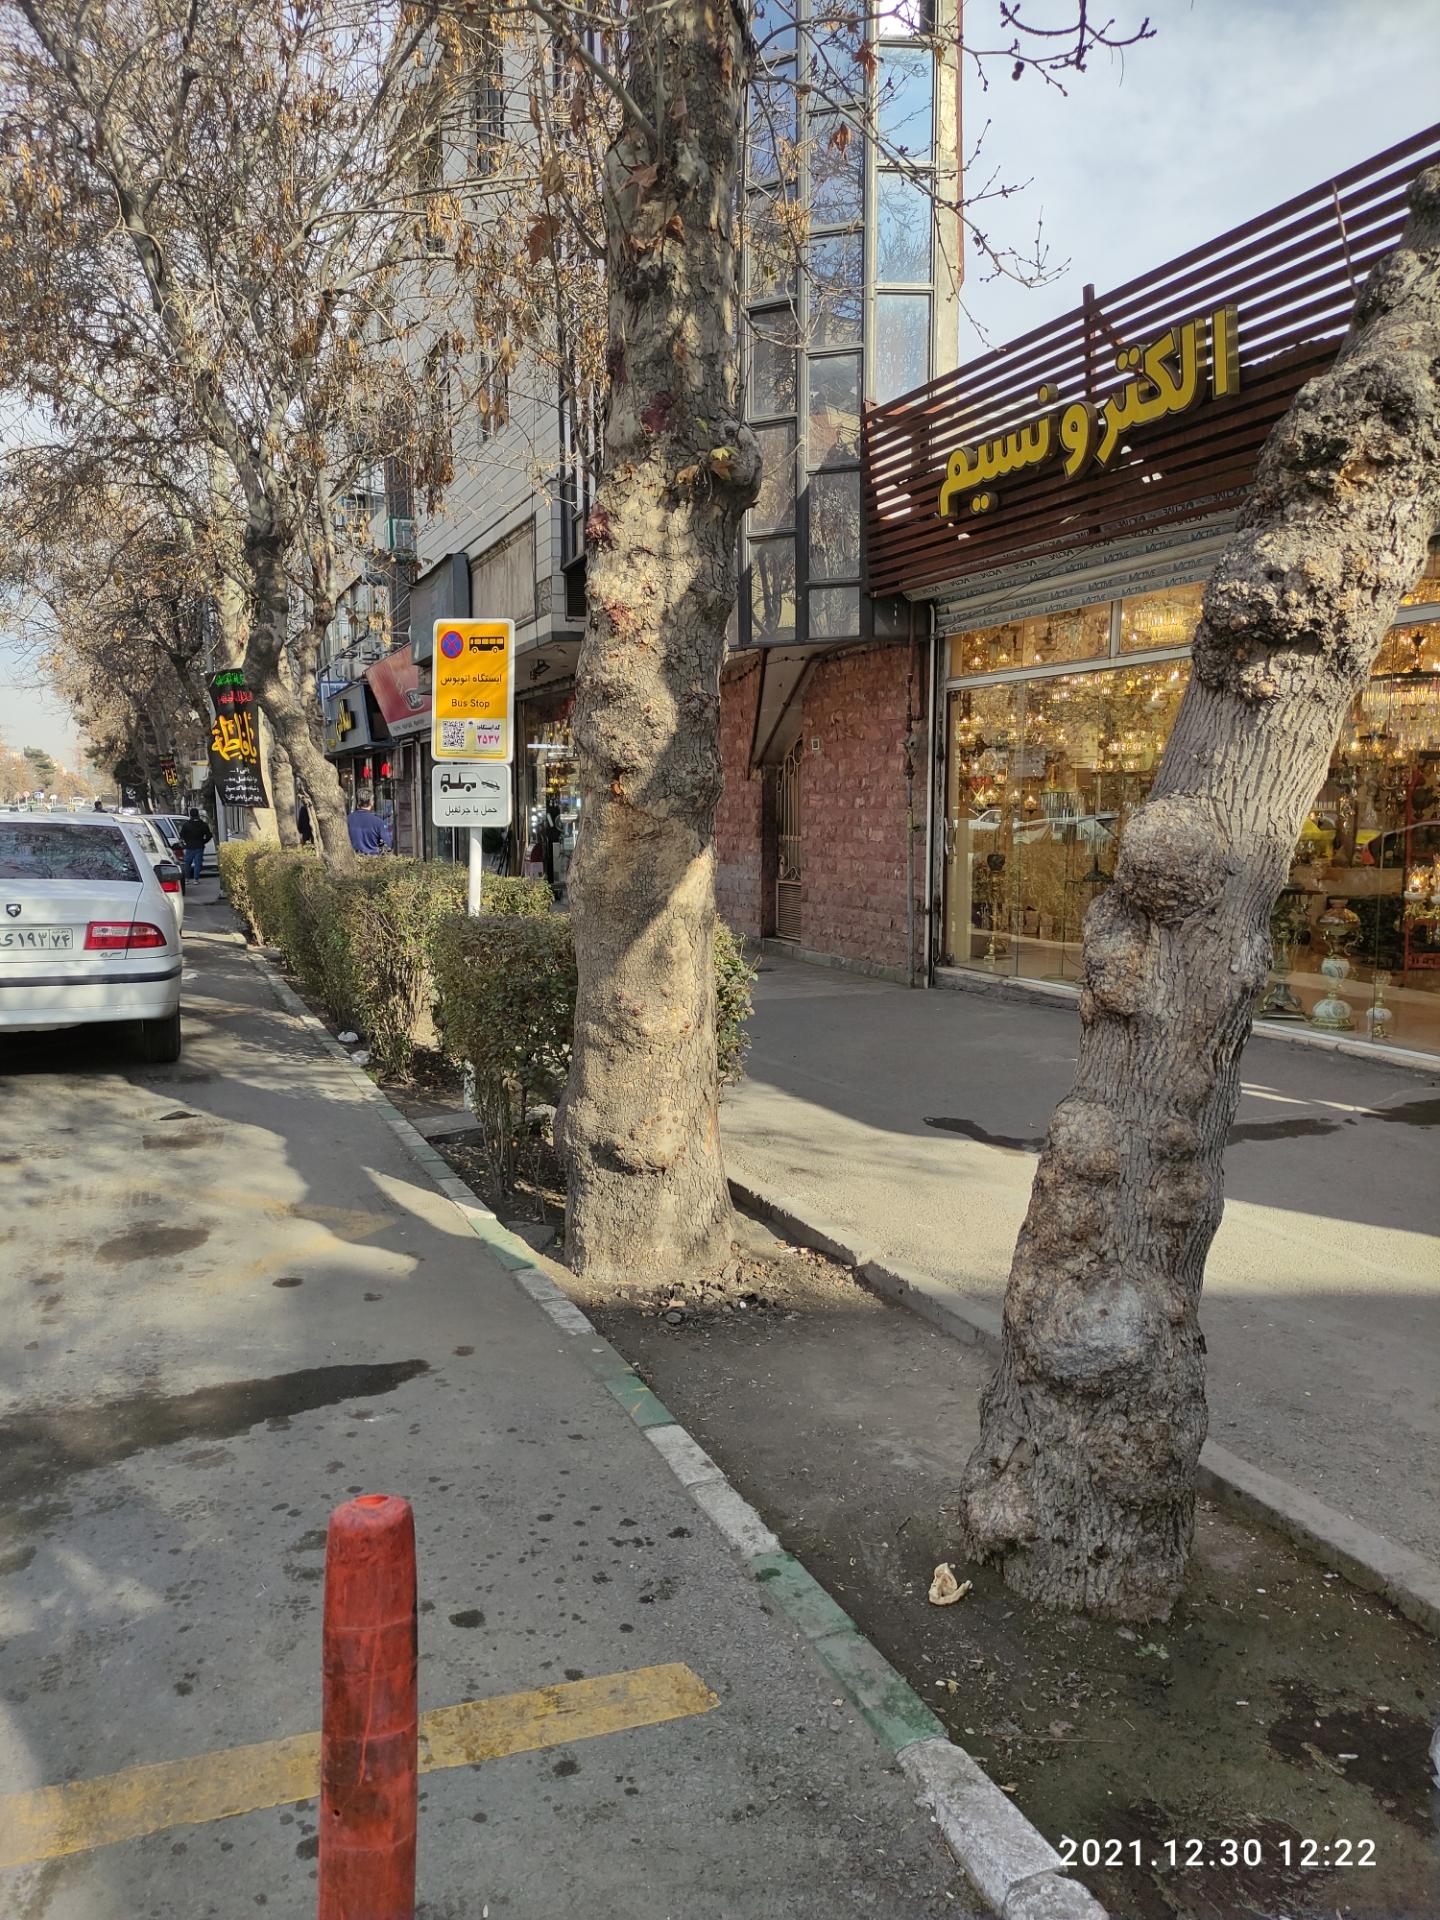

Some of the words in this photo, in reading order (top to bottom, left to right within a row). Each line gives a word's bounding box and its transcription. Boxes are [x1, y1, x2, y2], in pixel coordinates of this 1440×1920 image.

[440, 674, 470, 686] اتوبوس
[472, 673, 502, 684] ایستگاه
[451, 699, 468, 707] Bus
[471, 699, 490, 709] Stop
[477, 735, 500, 745] ۲۵۳۷
[444, 806, 471, 817] جرثقیل
[473, 805, 479, 813] با
[481, 806, 498, 816] حمل
[51, 934, 71, 947] ۷۴
